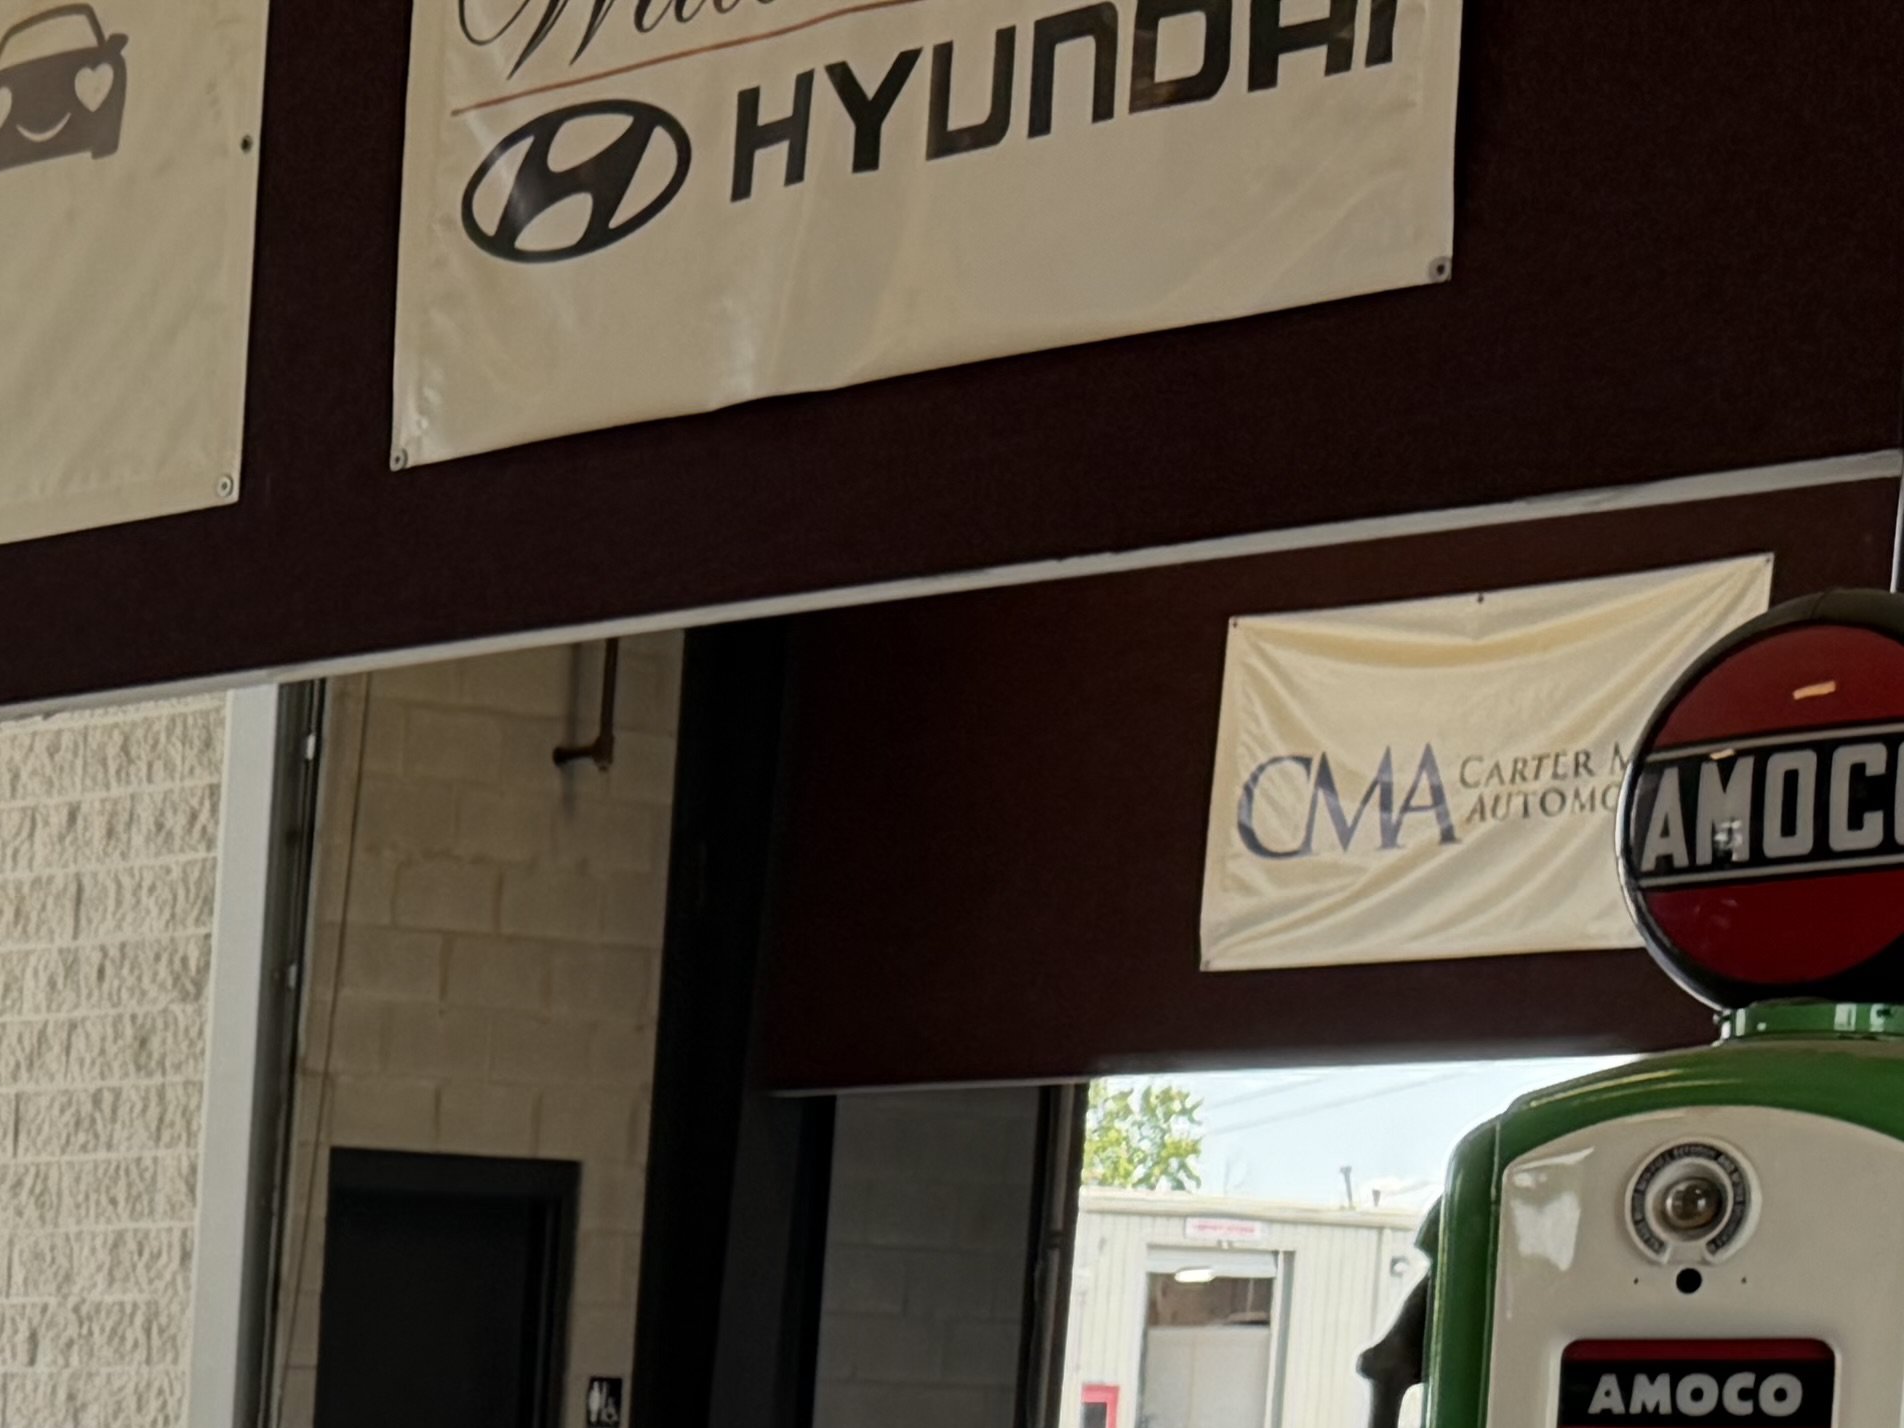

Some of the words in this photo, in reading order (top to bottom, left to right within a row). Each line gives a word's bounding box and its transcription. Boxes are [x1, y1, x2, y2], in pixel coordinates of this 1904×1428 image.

[731, 0, 1397, 203] HYUNDAI
[1236, 740, 1463, 862] CMA
[1458, 746, 1594, 788] CARTER
[1641, 743, 1904, 873] AMOC
[1587, 1371, 1805, 1418] AMOCO
